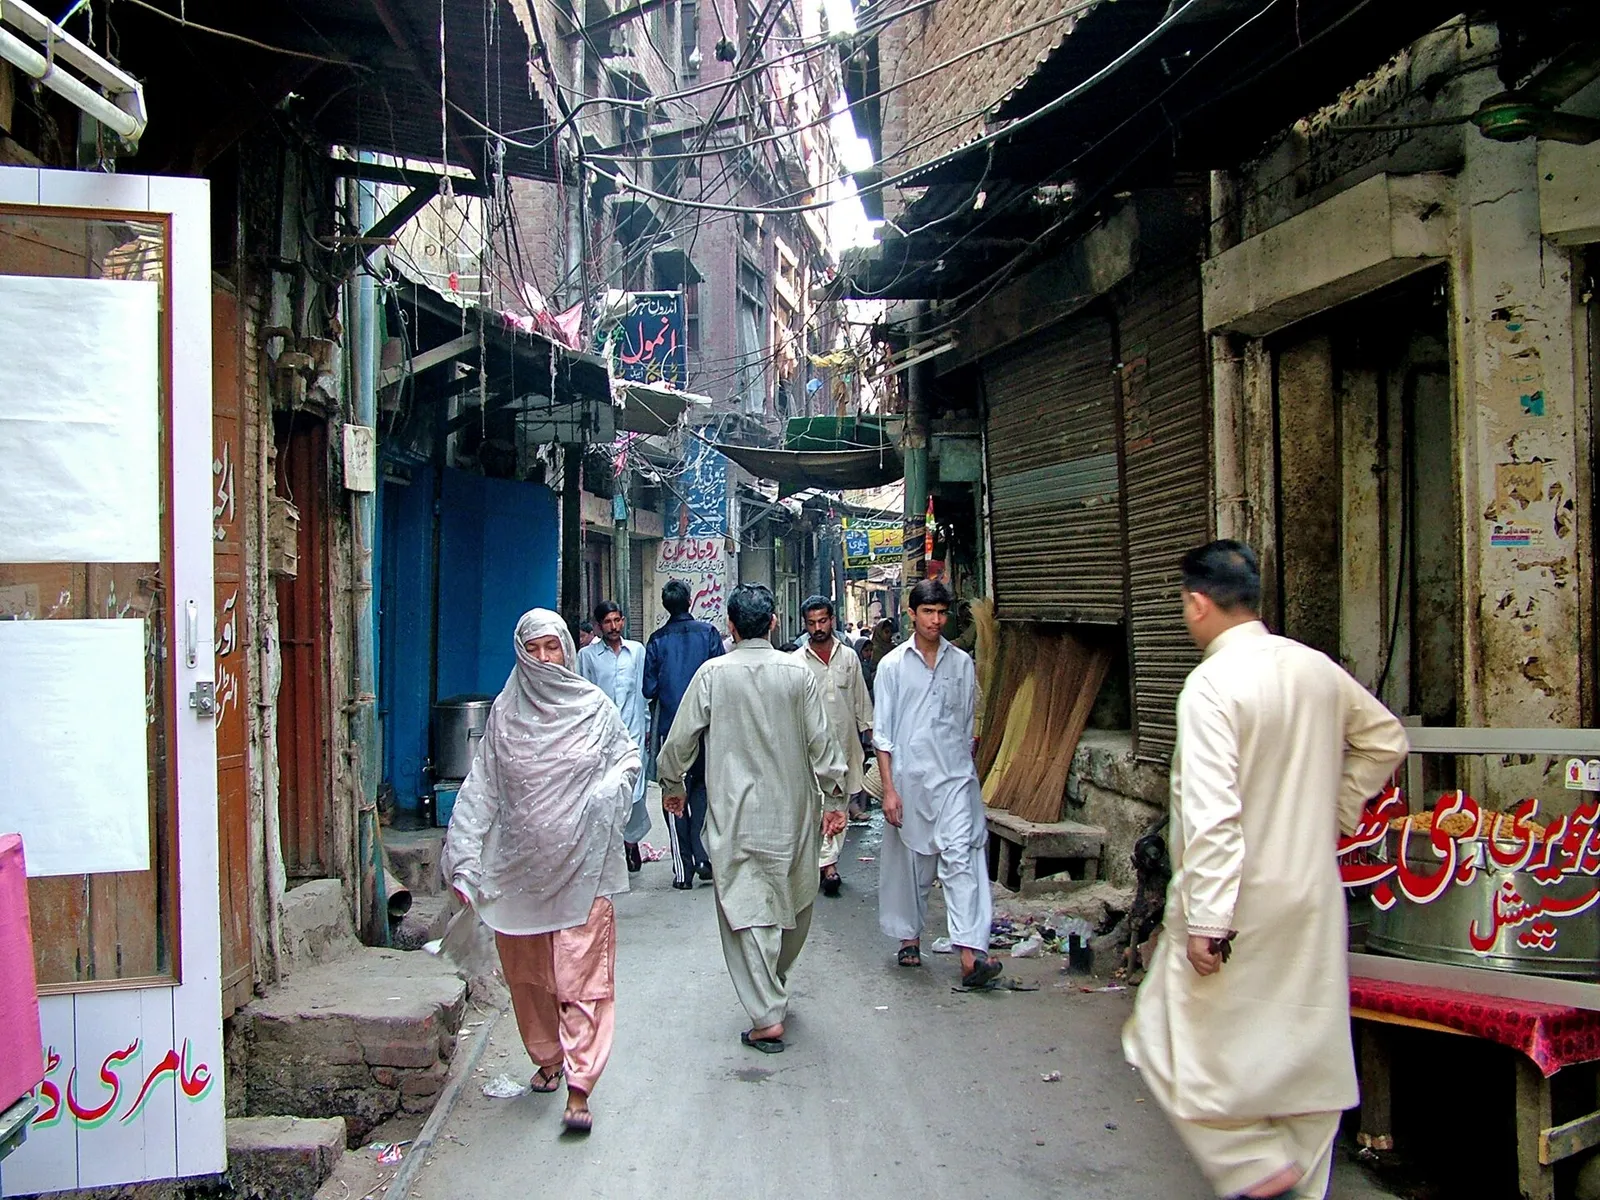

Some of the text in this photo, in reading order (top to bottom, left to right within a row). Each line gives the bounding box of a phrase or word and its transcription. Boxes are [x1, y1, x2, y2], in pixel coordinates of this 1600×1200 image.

[647, 299, 677, 315] اندرون
[621, 316, 676, 364] انمول
[663, 539, 719, 561] روحانی علاج
[1469, 881, 1600, 957] سپیشل
[66, 1037, 142, 1127] سی
[119, 1037, 213, 1124] عامر
